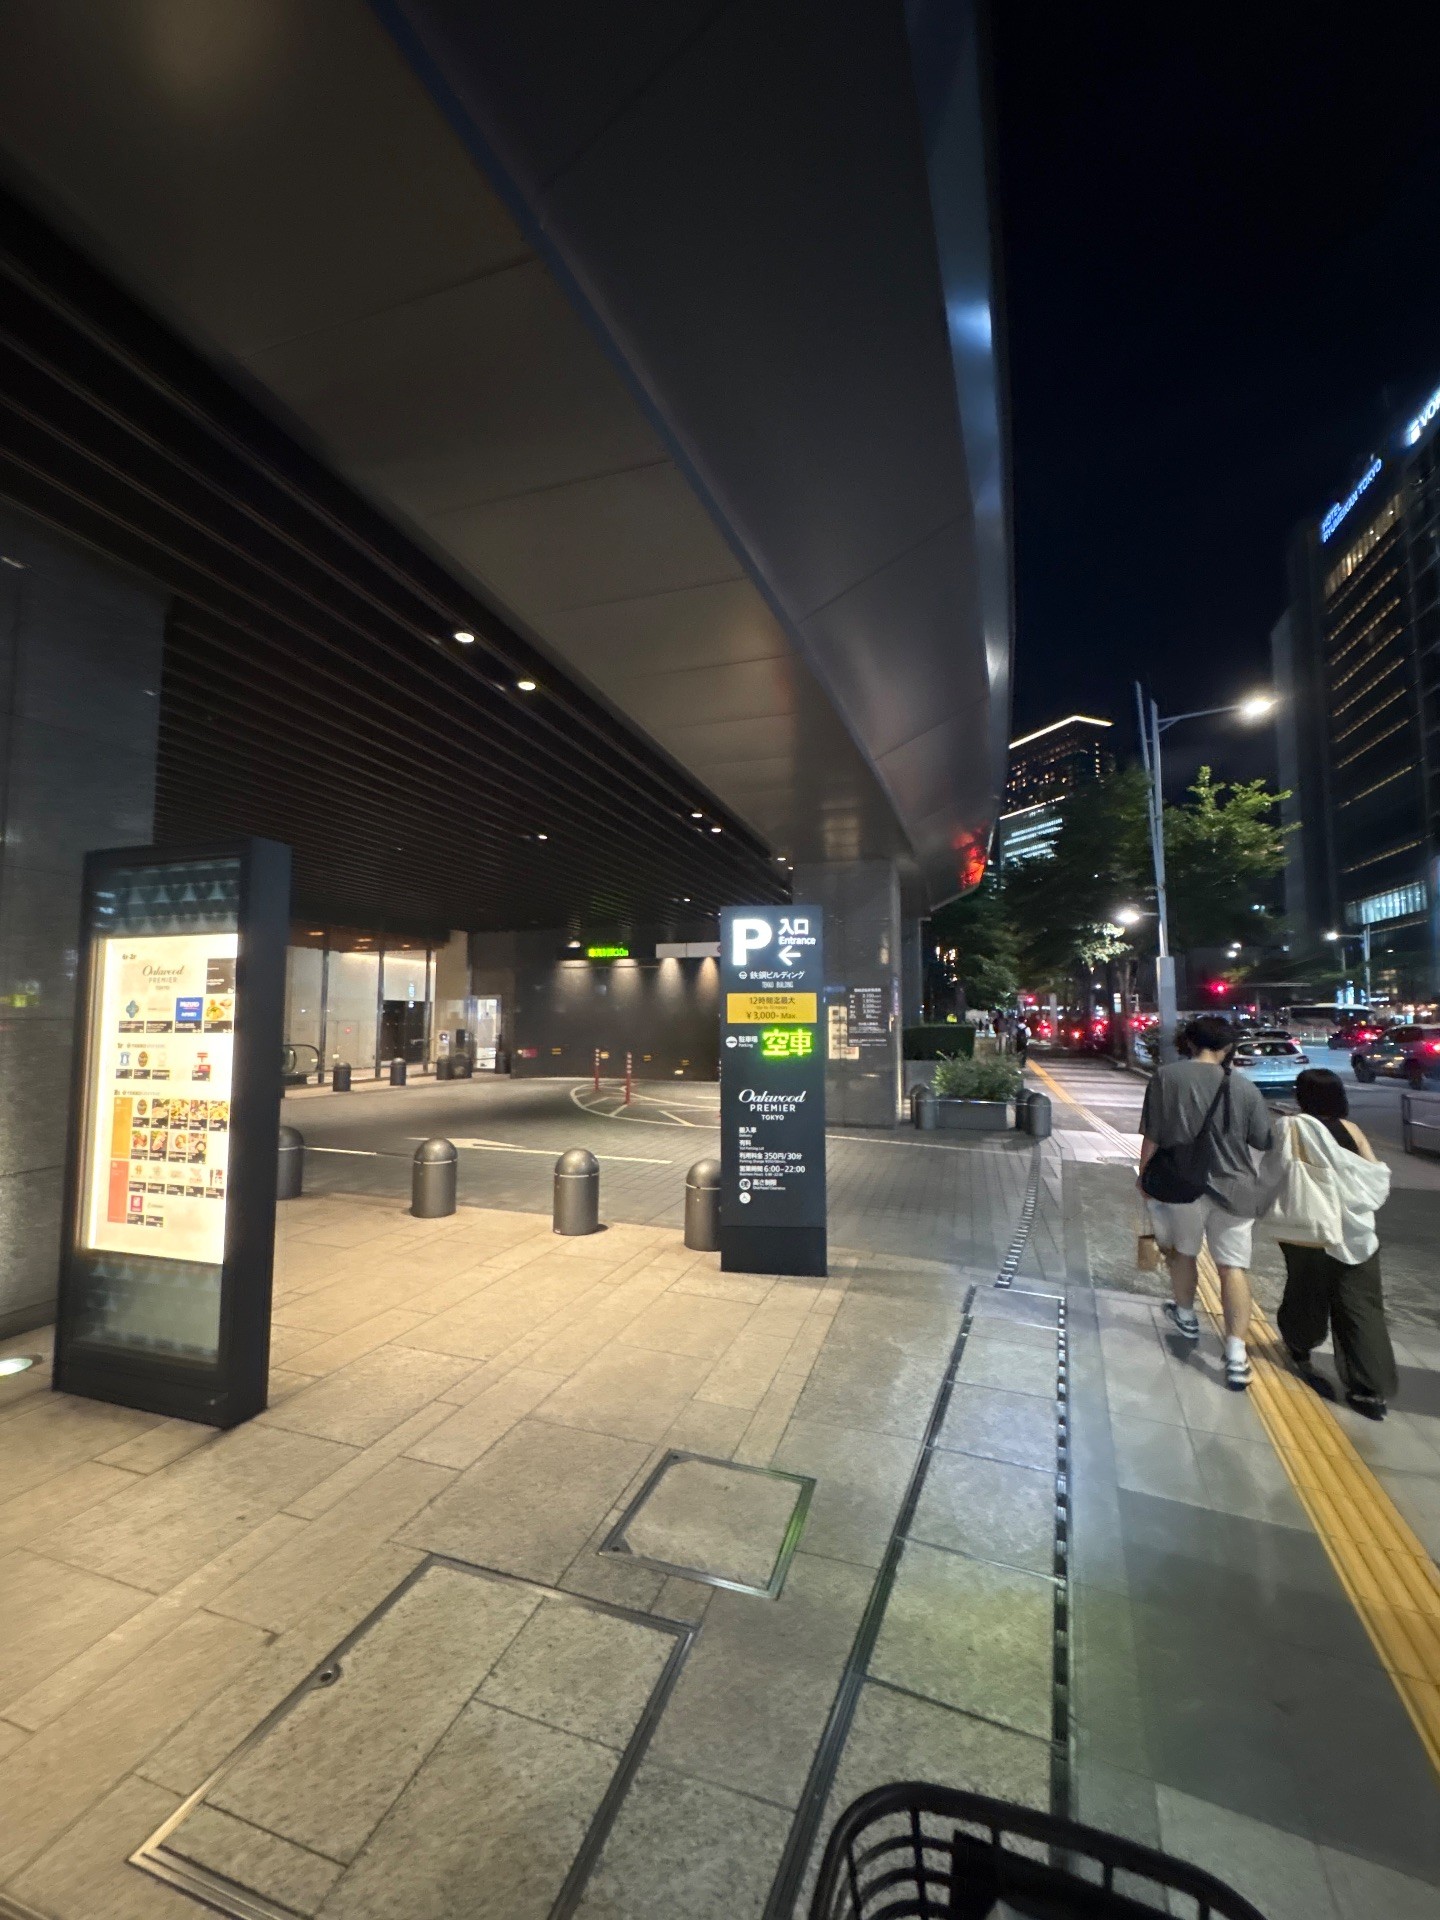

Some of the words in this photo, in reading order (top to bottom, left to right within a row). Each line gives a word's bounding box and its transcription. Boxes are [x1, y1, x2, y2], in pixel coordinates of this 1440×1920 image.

[1357, 458, 1382, 494] TOKYO
[778, 918, 809, 936] 入口
[732, 918, 772, 966] P
[778, 936, 816, 945] Entrance
[749, 970, 805, 980] 鉄鋼ビルディング
[762, 1028, 812, 1056] 空車
[738, 1088, 807, 1103] Oakwood
[749, 1103, 796, 1112] PREMIER
